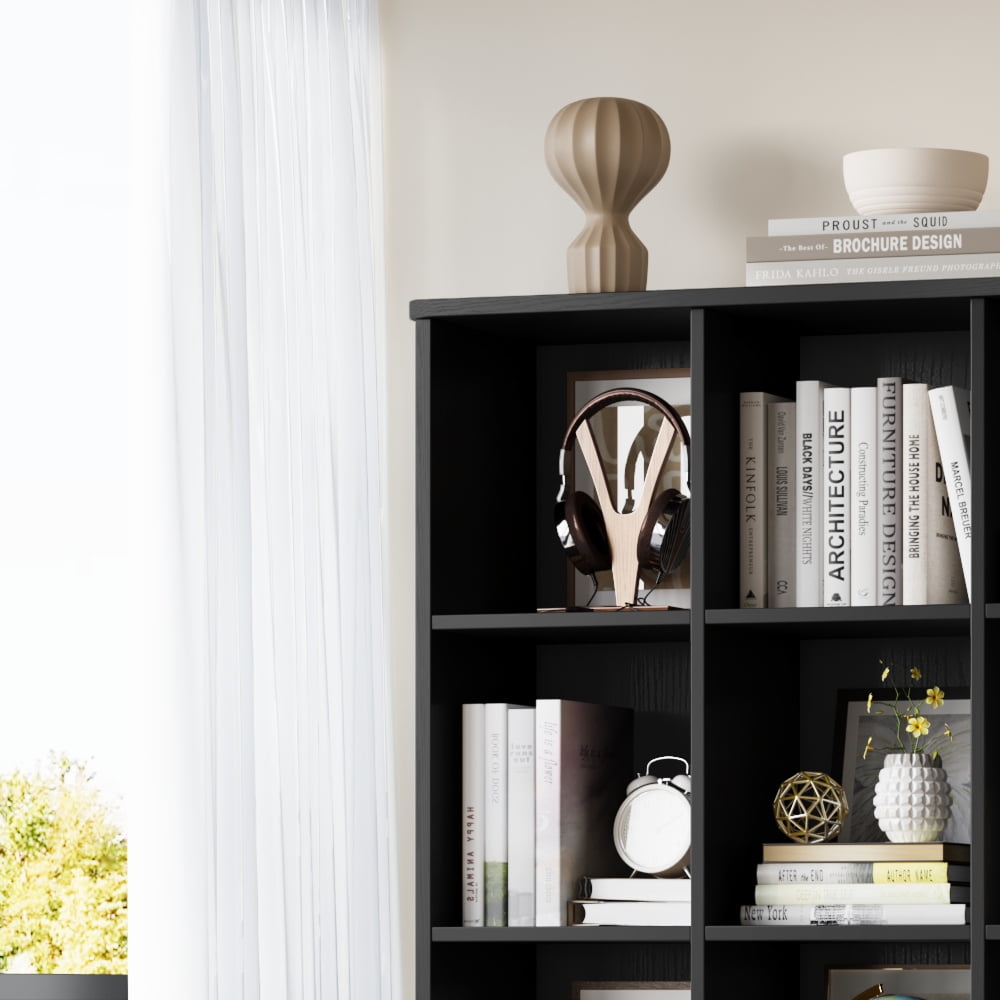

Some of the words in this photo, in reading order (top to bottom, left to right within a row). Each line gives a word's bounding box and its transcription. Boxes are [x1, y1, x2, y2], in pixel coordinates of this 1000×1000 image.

[822, 219, 878, 231] PROUST
[913, 216, 948, 228] SQUID
[833, 236, 909, 254] BROCHURE
[912, 233, 963, 250] DESIGN
[754, 269, 792, 281] FRIDA
[796, 267, 839, 279] KAHLO
[802, 433, 813, 464] BLACK
[882, 382, 896, 516] FURNITURE
[908, 434, 920, 460] HOME
[776, 466, 788, 485] LOUIS
[856, 442, 869, 497] Constructing
[908, 462, 920, 492] HOUSE
[745, 456, 756, 522] KINFOLK
[776, 486, 789, 516] SULLIVAN
[828, 410, 845, 582] ARCHITECTURE
[908, 494, 920, 512] THE
[950, 461, 966, 499] MARCEL
[958, 501, 972, 539] BREUER
[858, 500, 869, 536] Paradies
[908, 515, 920, 559] BRINGING
[882, 524, 896, 607] DESIGN
[778, 869, 797, 882] AFTER
[810, 869, 824, 882] END
[887, 869, 911, 882] AUTHOR
[915, 869, 933, 882] NAME
[744, 905, 765, 921] New
[767, 904, 788, 921] York
